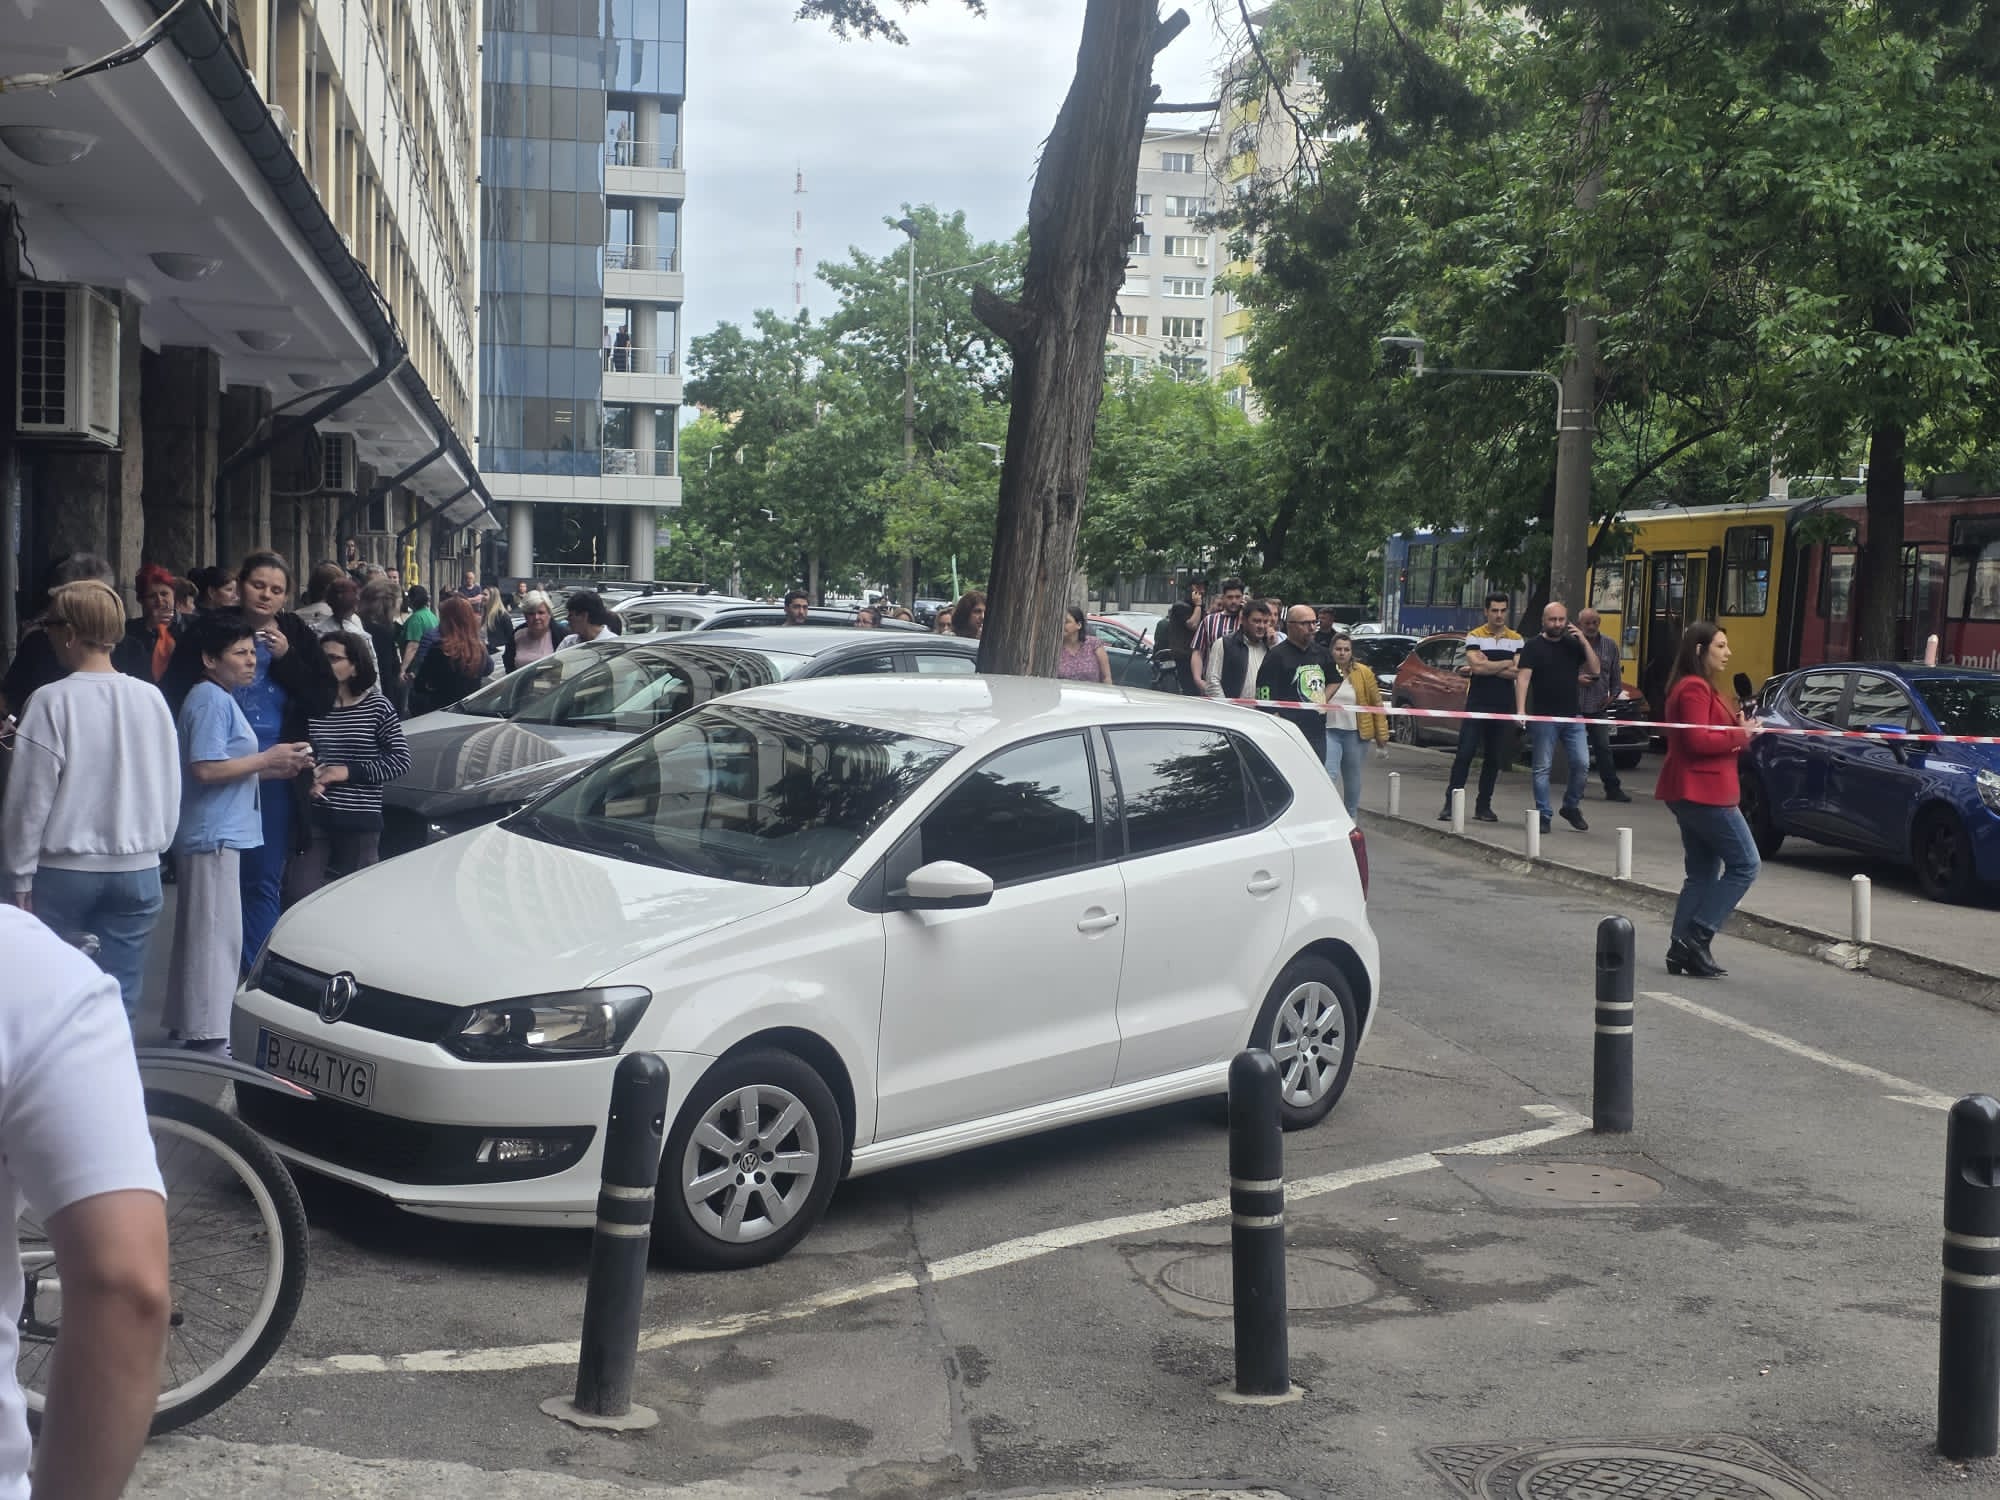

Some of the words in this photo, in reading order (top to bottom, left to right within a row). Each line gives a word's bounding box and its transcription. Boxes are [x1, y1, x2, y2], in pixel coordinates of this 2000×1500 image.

[267, 1036, 281, 1069] B
[287, 1044, 321, 1085] 444
[325, 1055, 367, 1098] TYG
